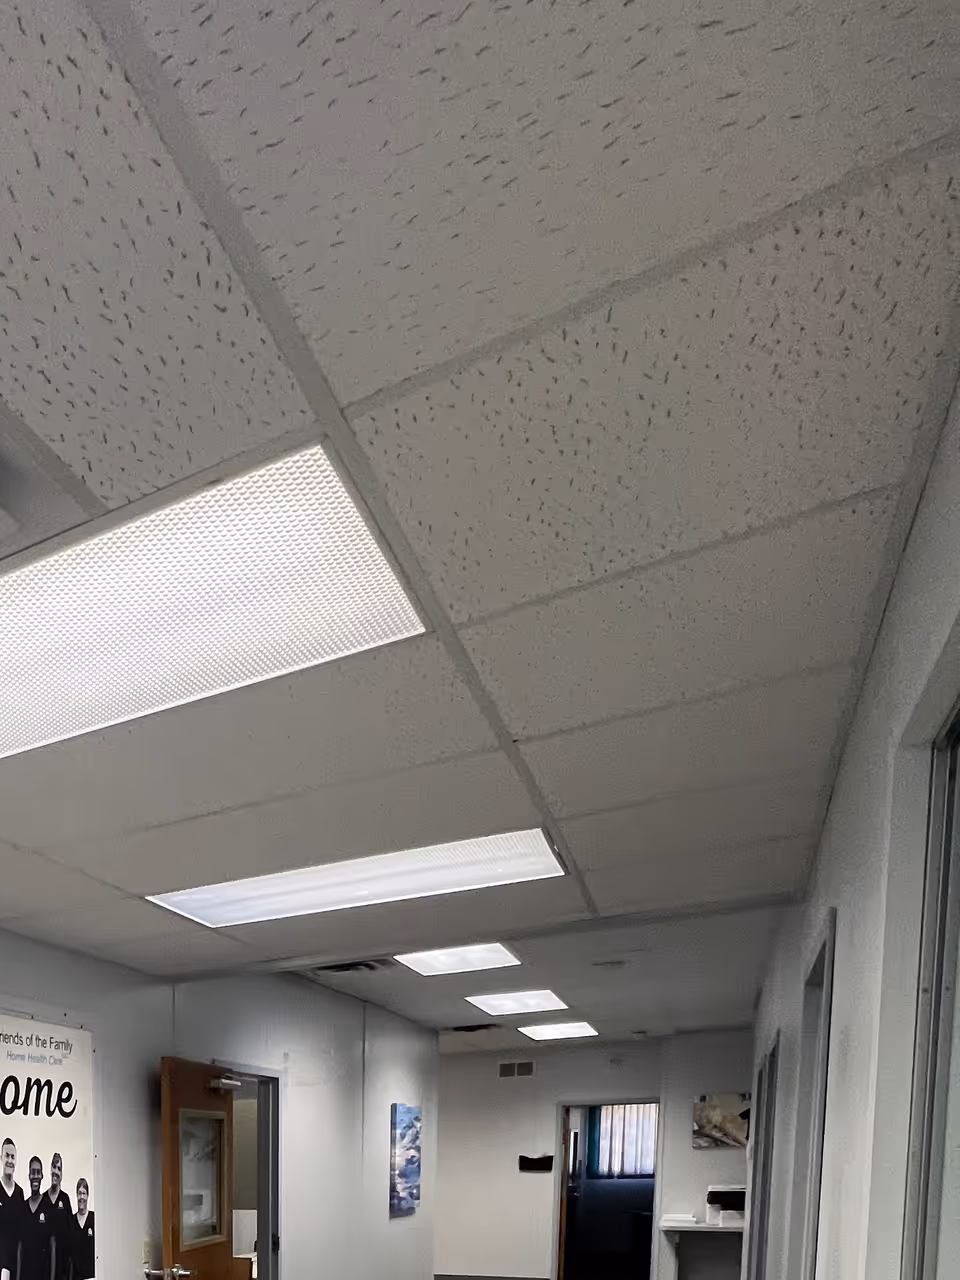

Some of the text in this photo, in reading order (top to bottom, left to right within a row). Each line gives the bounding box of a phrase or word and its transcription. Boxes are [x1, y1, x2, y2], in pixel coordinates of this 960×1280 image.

[25, 1033, 34, 1047] of
[35, 1035, 48, 1049] the
[49, 1036, 73, 1055] Family
[6, 1050, 26, 1062] Home
[27, 1052, 48, 1064] Health
